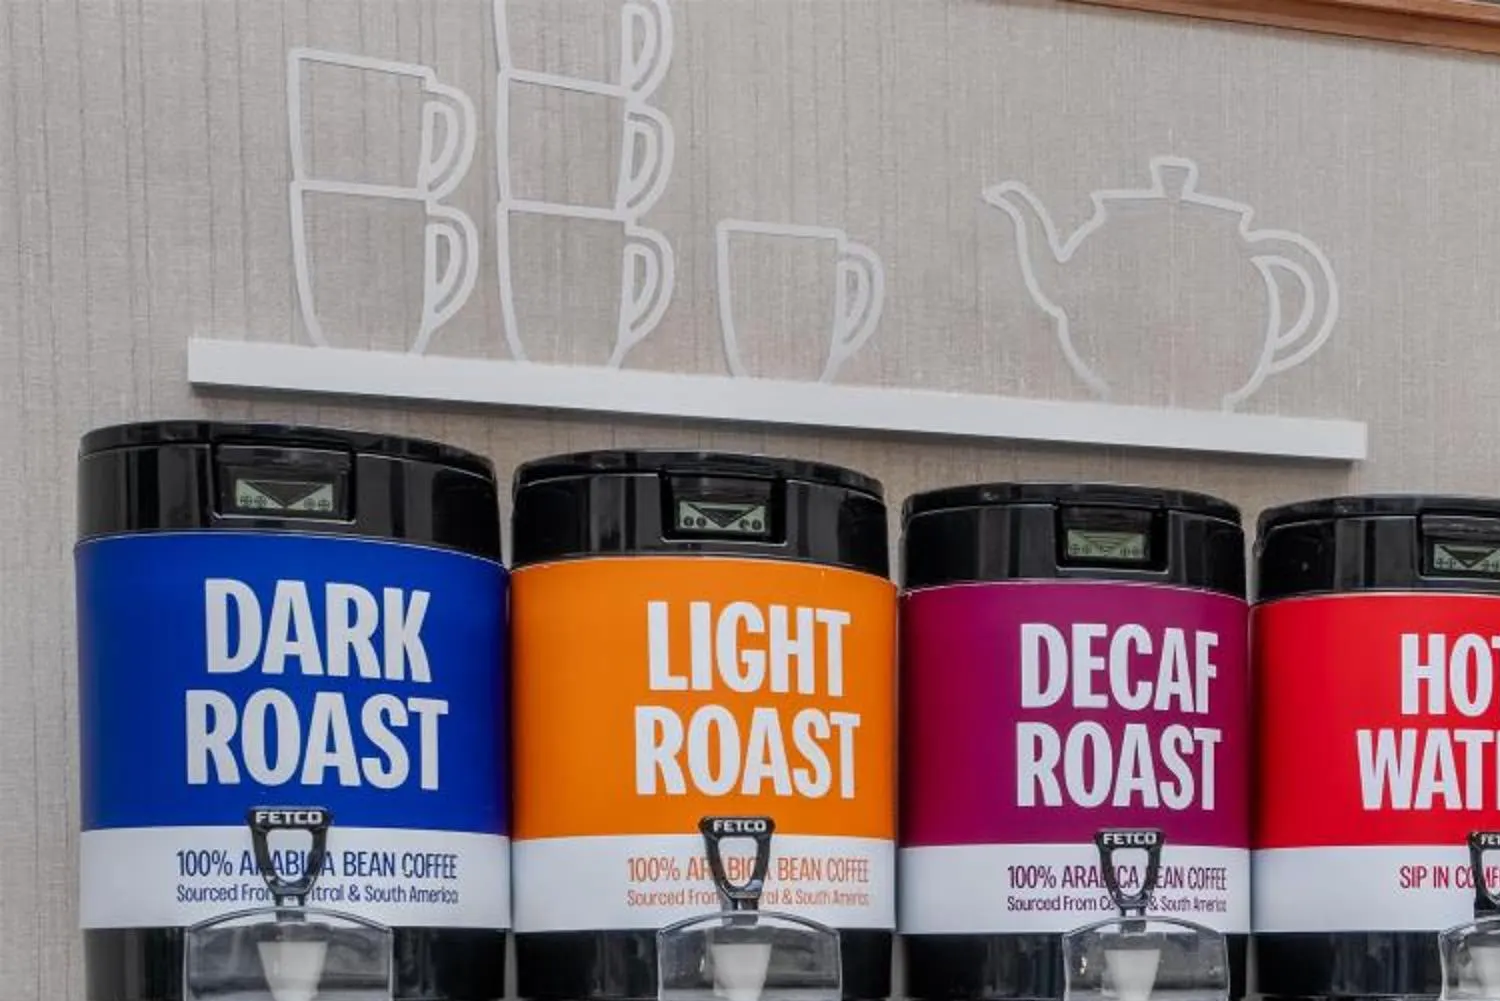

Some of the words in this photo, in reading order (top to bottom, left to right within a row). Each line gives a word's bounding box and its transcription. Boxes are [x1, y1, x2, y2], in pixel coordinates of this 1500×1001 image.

[206, 579, 431, 683] DARK
[648, 601, 851, 697] LIGHT
[1021, 623, 1218, 714] DECAF
[187, 688, 449, 790] ROAST
[635, 704, 861, 799] ROAST
[1016, 721, 1222, 810] ROAST
[255, 811, 323, 825] FETCO
[713, 819, 767, 833] FETCO
[1103, 832, 1158, 845] FETCO
[176, 849, 233, 877] 100%
[239, 849, 336, 877] AABIA
[343, 851, 396, 877] BEAN
[401, 852, 459, 879] COFFEE
[627, 856, 681, 882] 100%
[686, 855, 773, 881] ARBIC
[777, 857, 822, 881] BEAN
[827, 857, 870, 883] COFFEE
[1400, 865, 1427, 889] SIP
[1433, 865, 1449, 889] IN
[1007, 865, 1057, 889] 100%
[1061, 865, 1140, 889] ARACA
[1154, 865, 1184, 889] EAN
[1187, 866, 1227, 890] COFFEE
[176, 883, 238, 903] Sourced
[349, 884, 361, 902] &
[364, 885, 407, 903] South
[627, 888, 685, 906] Sourced
[781, 888, 793, 905] &
[1007, 894, 1061, 912] Sourced
[1063, 894, 1097, 911] From
